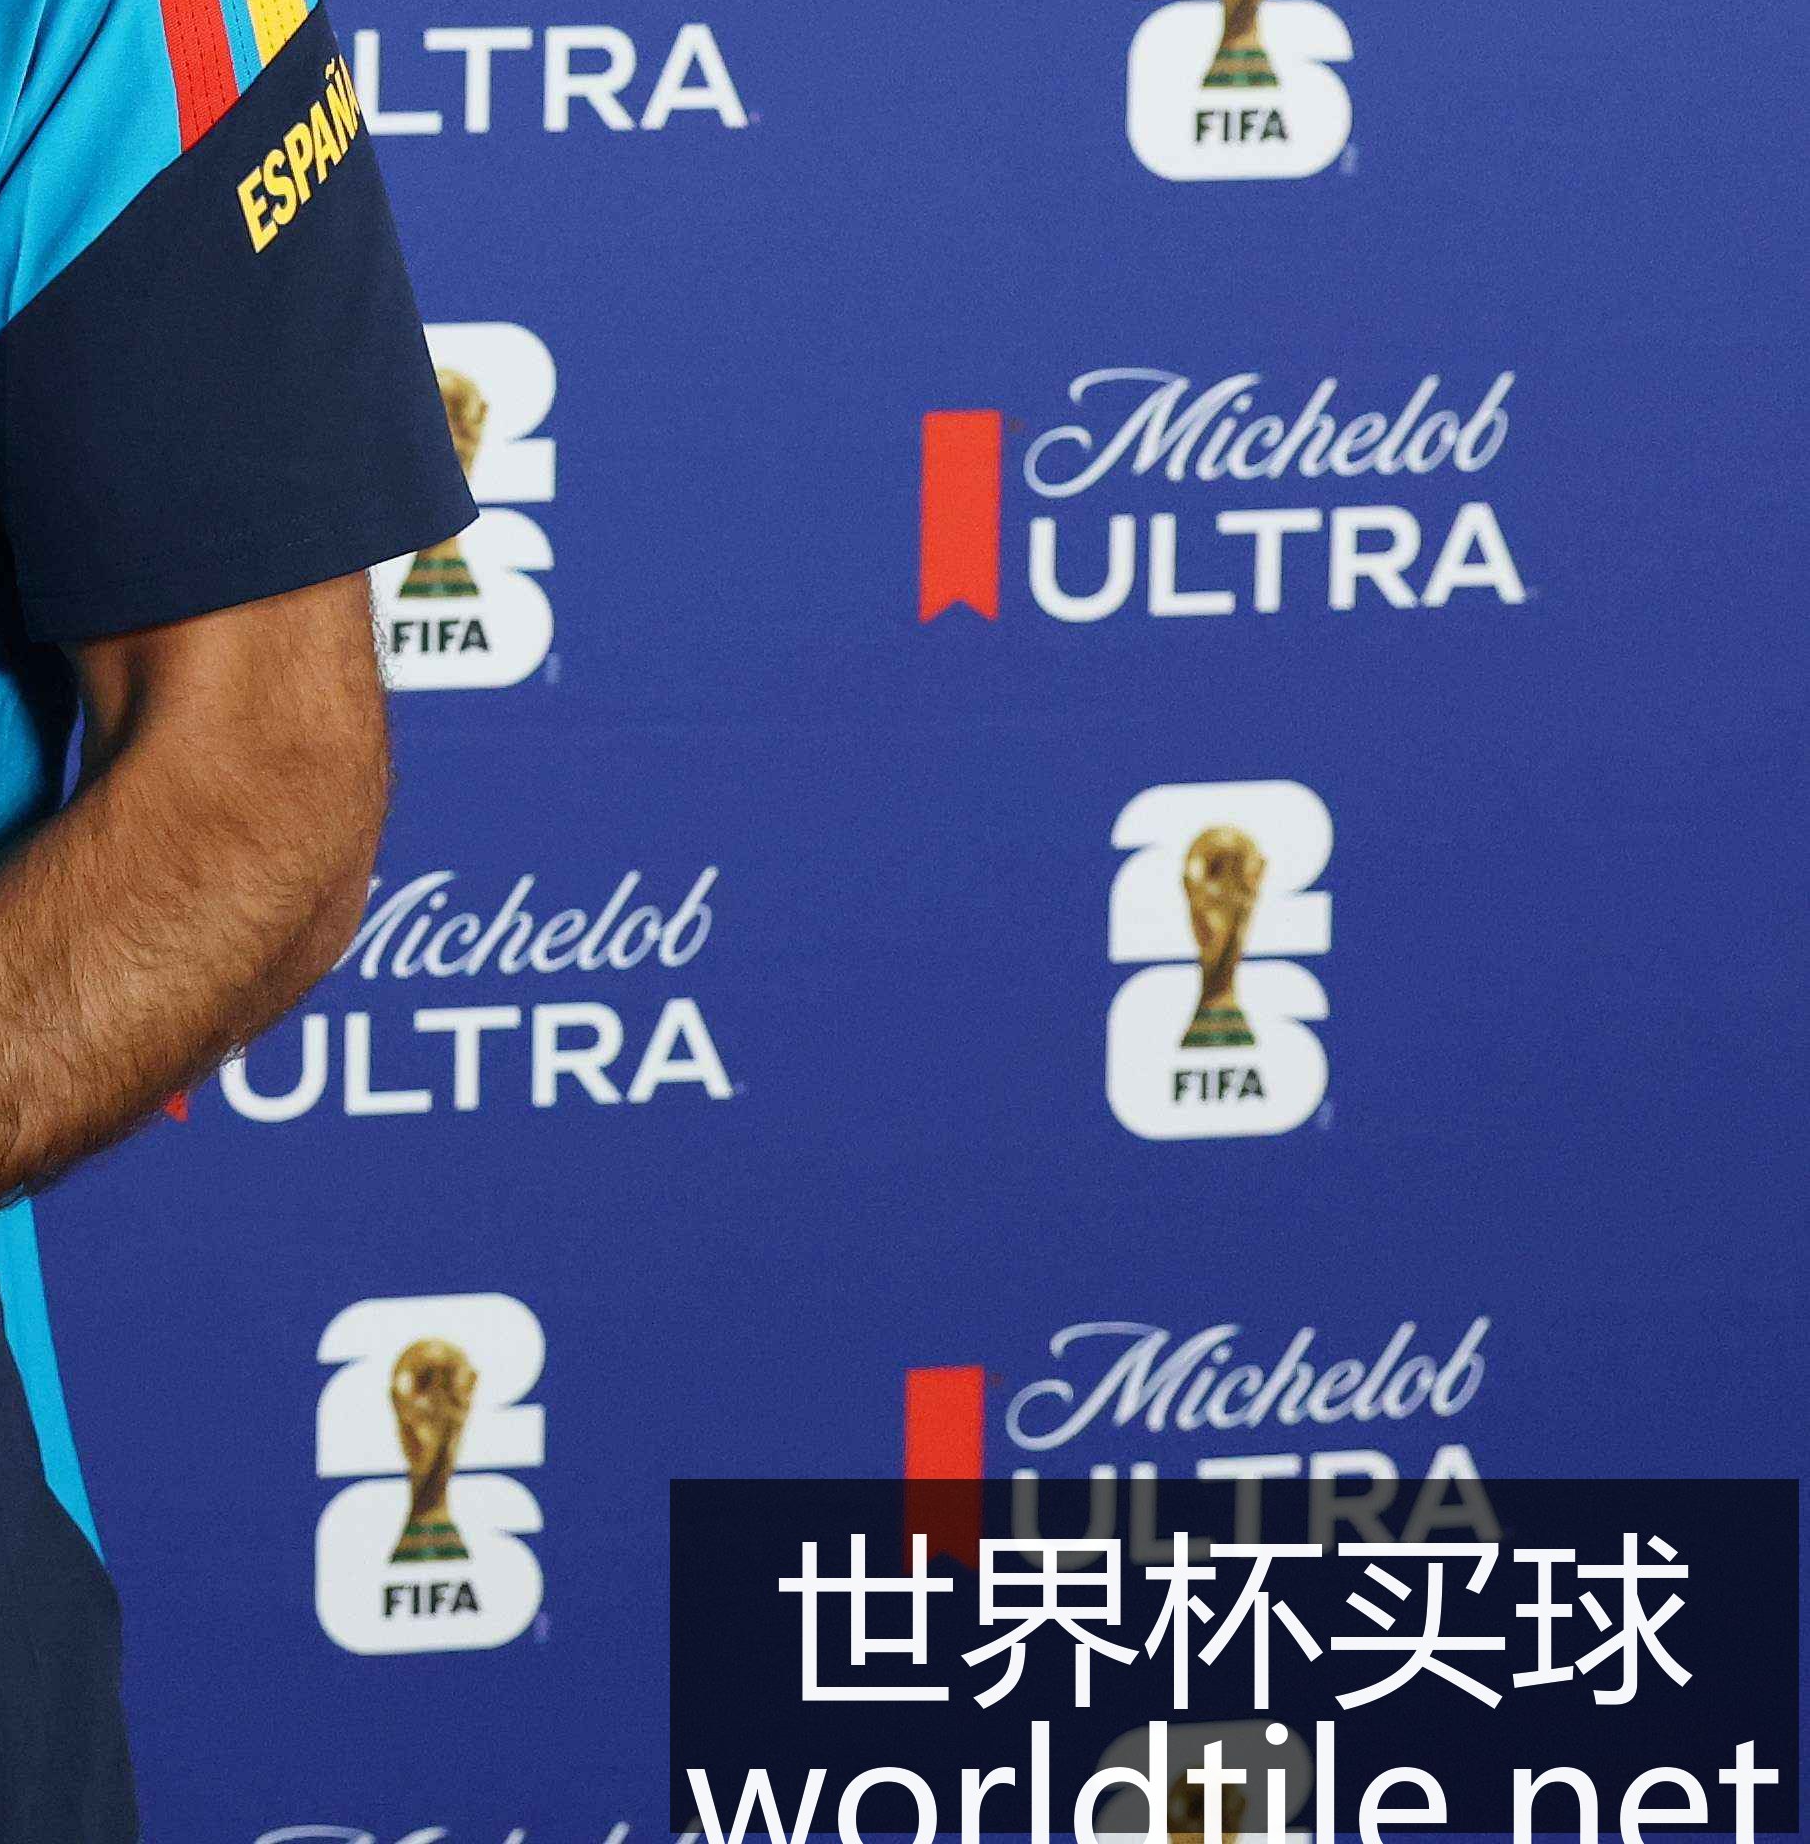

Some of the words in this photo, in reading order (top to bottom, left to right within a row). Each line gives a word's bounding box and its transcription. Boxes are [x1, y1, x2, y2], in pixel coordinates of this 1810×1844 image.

[352, 23, 749, 135] LTRA
[1194, 108, 1289, 144] FIFA
[236, 53, 361, 254] ESPAÑ
[1023, 367, 1515, 499] Michelob
[1028, 501, 1530, 623] ULTRA
[392, 618, 490, 654] FIFA
[218, 997, 735, 1123] ULTRA
[1172, 1067, 1266, 1103] FIFA
[1005, 1316, 1491, 1451] Michelob
[1008, 1443, 1504, 1570] ULTRA
[383, 1580, 480, 1618] FIFA
